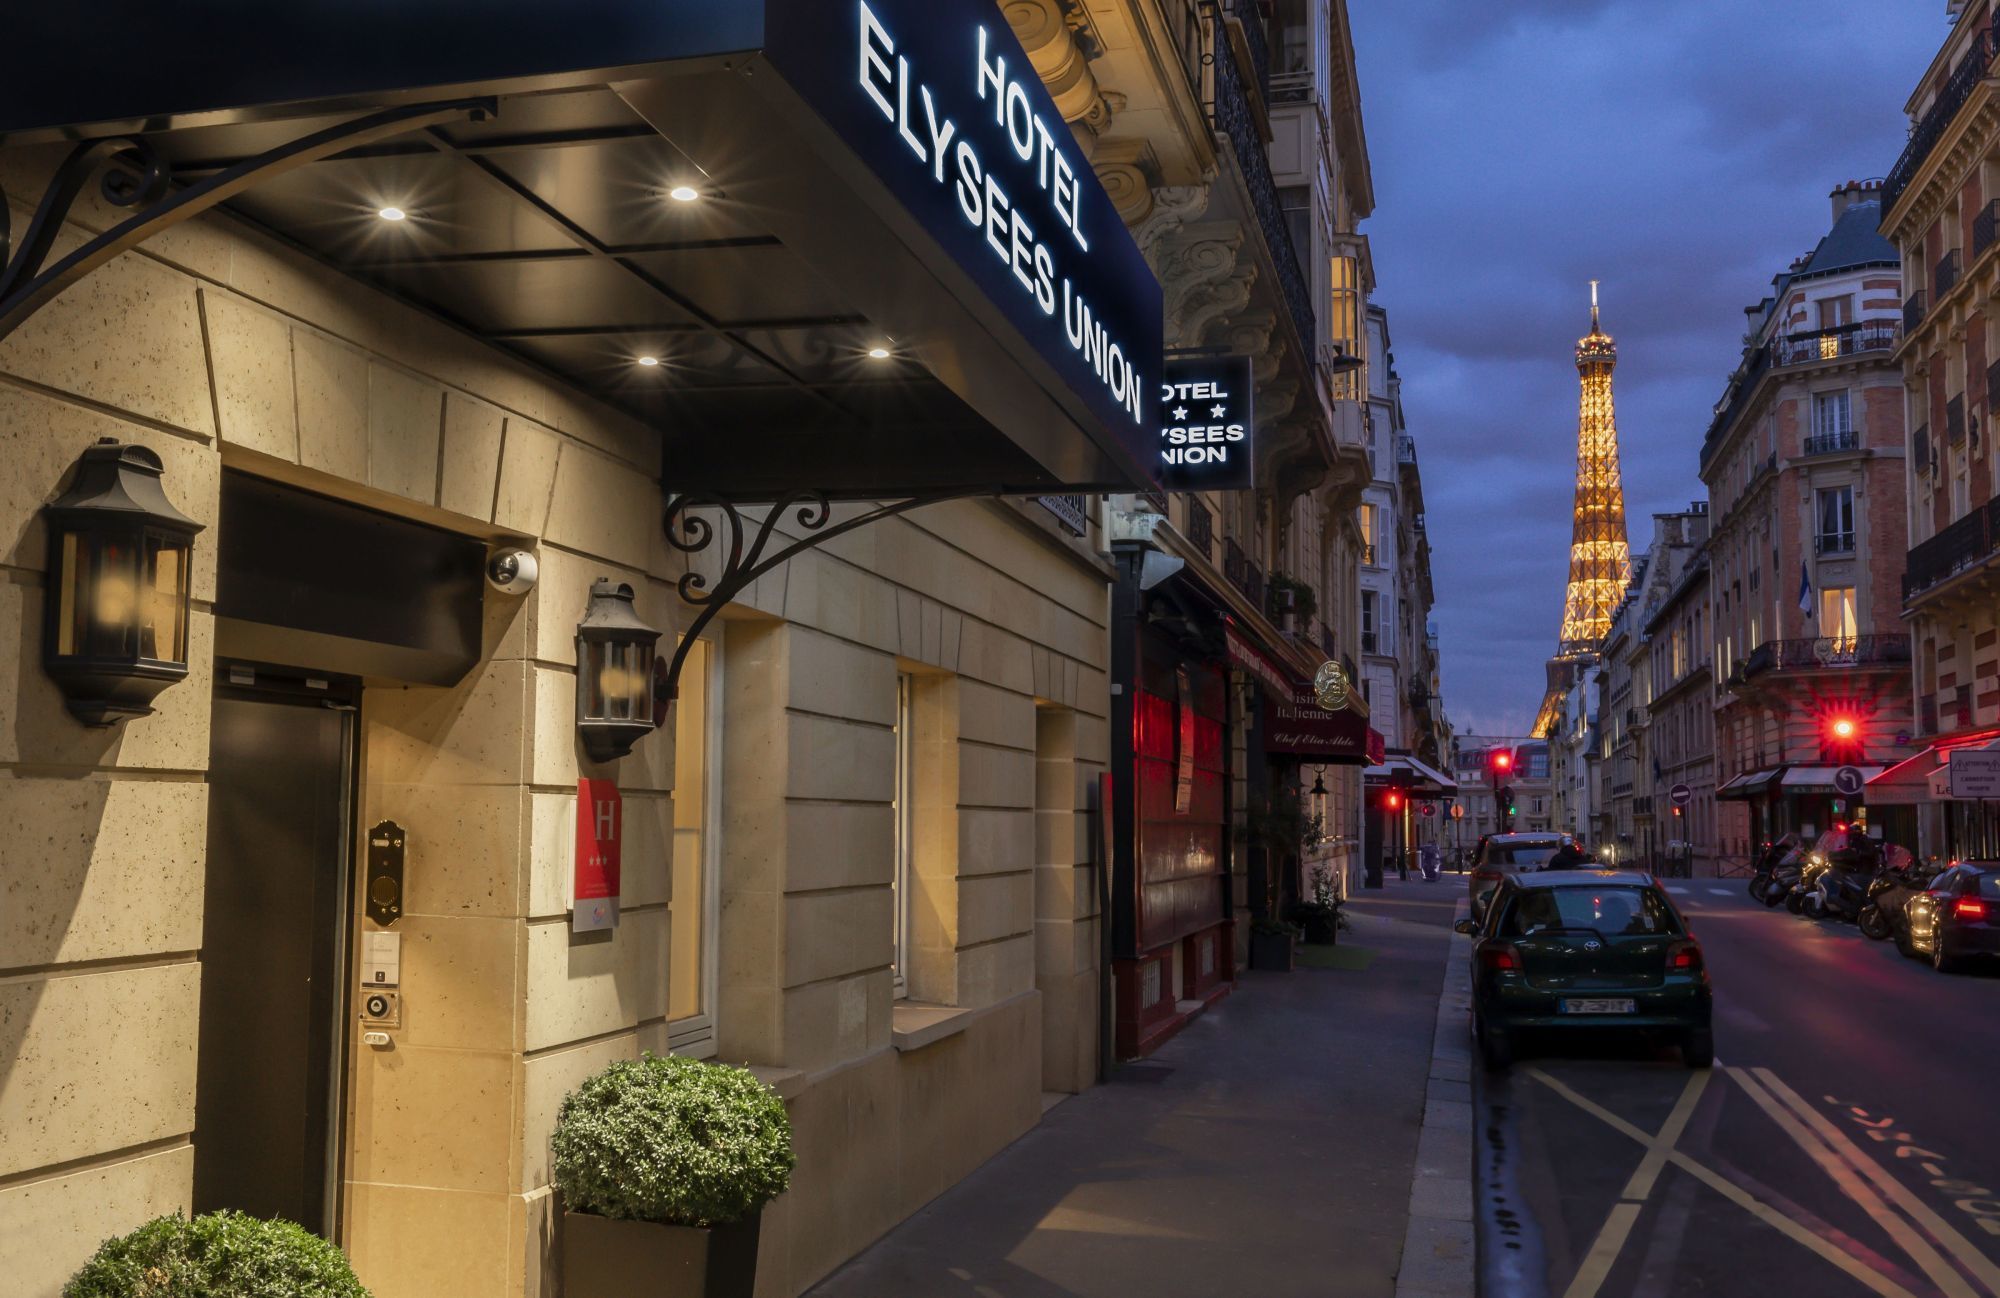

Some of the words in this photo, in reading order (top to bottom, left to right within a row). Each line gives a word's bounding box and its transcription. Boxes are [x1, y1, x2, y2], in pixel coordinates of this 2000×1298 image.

[978, 25, 1088, 253] HOTEL
[859, 0, 1055, 316] ELYSEES
[1064, 278, 1141, 425] UNION
[1161, 382, 1228, 402] OTEL
[1161, 446, 1227, 465] NION
[1274, 733, 1301, 747] Chef
[594, 800, 616, 841] H
